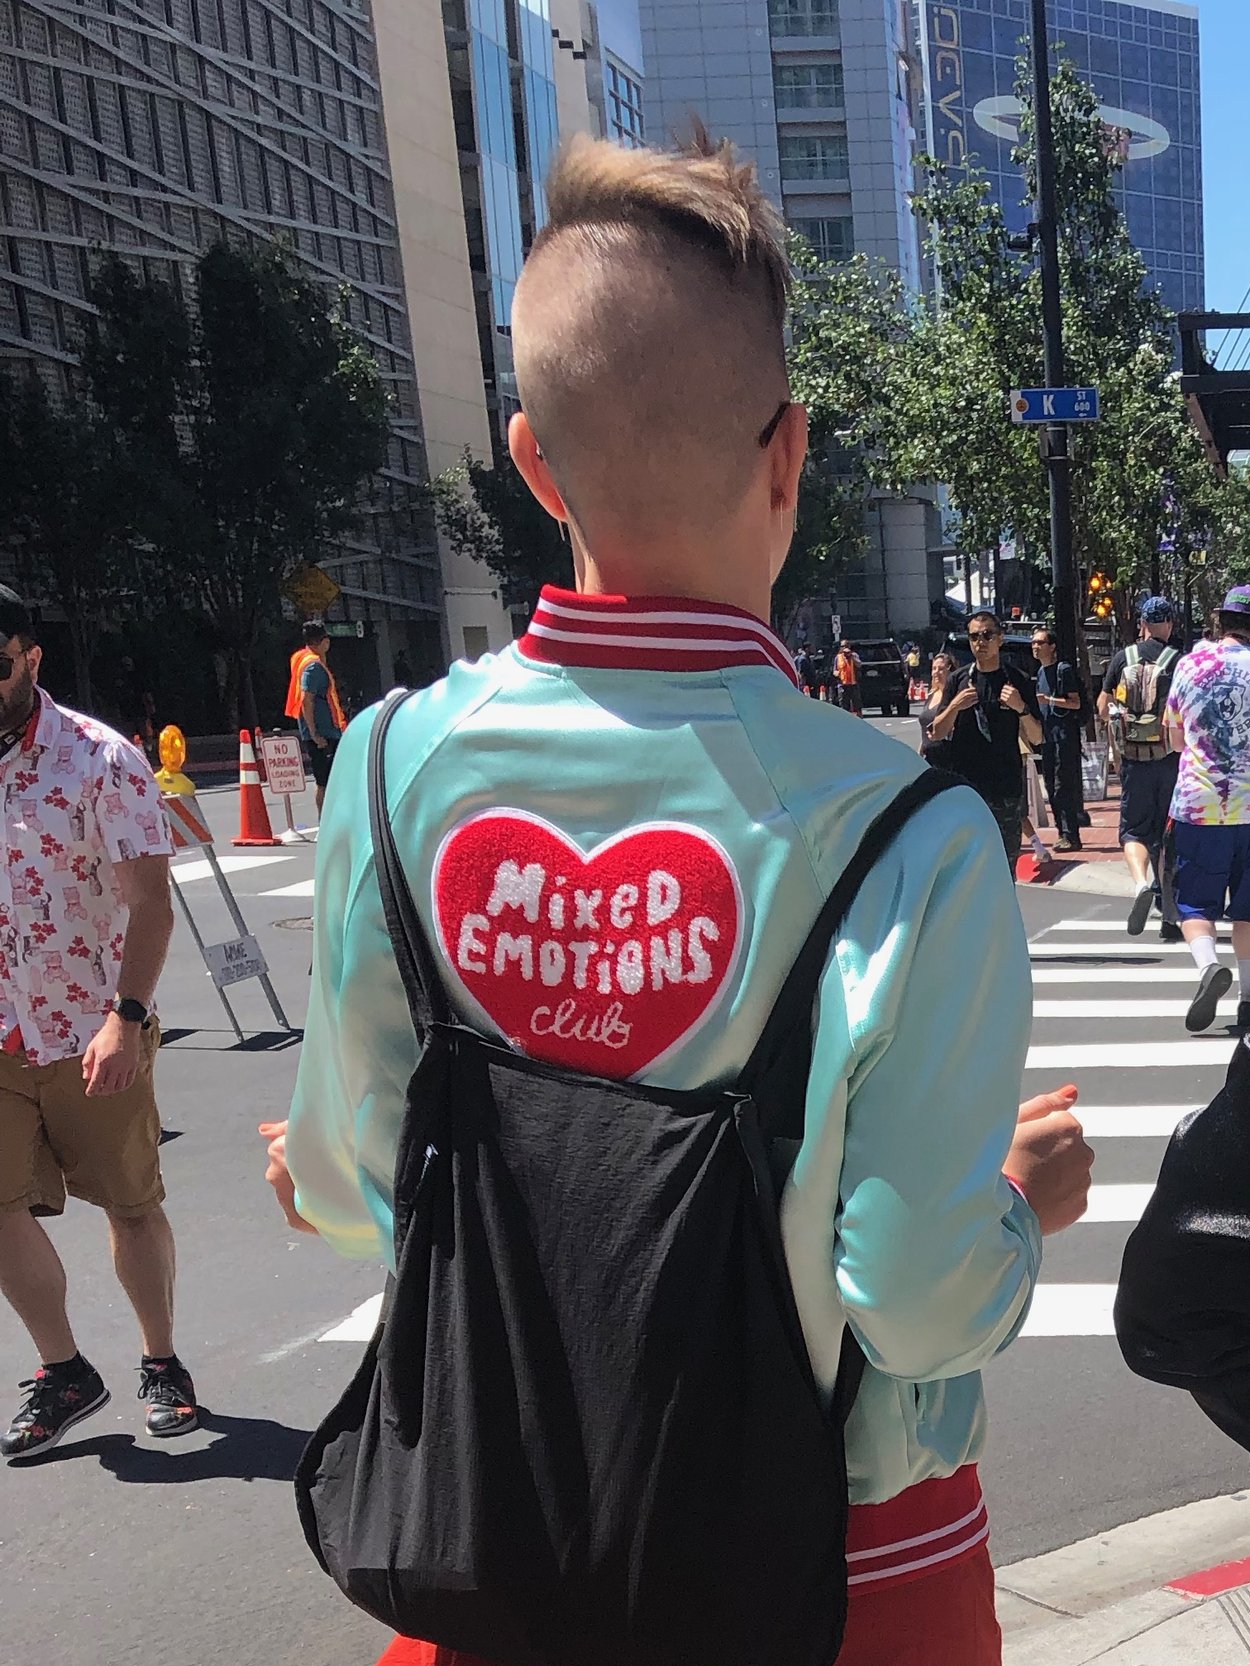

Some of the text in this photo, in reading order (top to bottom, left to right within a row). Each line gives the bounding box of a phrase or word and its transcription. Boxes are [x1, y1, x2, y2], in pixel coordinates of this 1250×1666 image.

[1042, 391, 1087, 416] K ST
[273, 743, 289, 755] NO
[268, 756, 299, 768] PARKING
[279, 780, 296, 788] ZONE
[530, 998, 632, 1049] club
